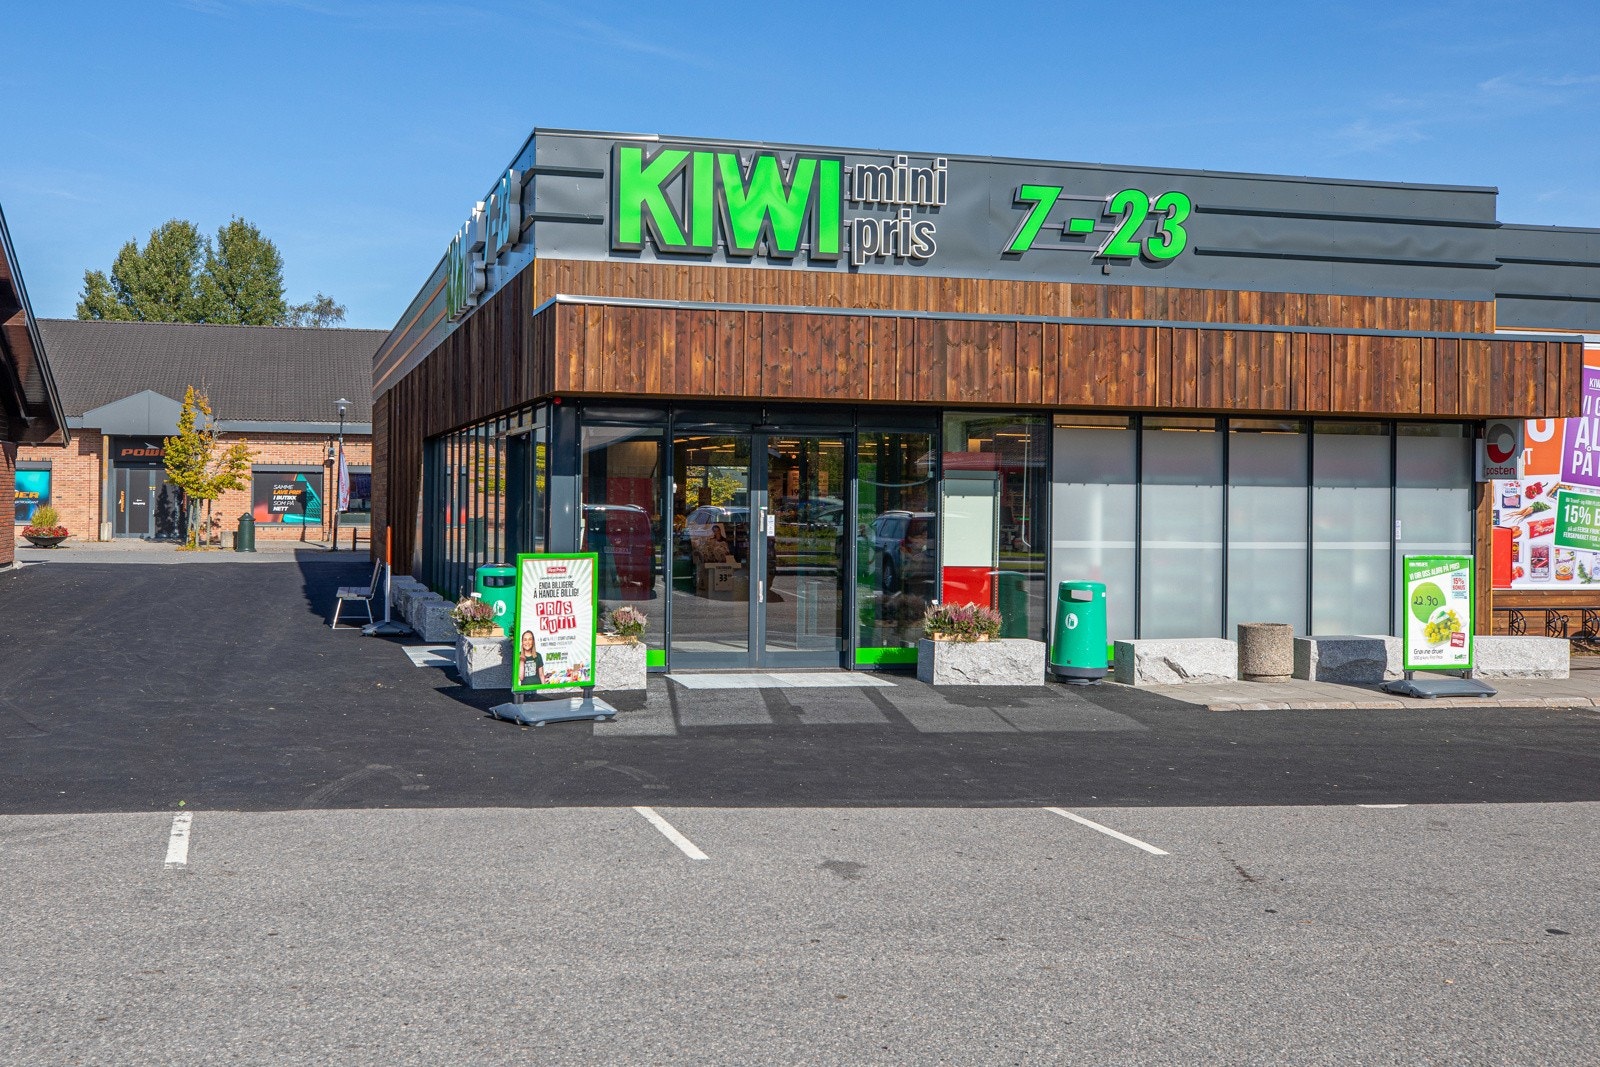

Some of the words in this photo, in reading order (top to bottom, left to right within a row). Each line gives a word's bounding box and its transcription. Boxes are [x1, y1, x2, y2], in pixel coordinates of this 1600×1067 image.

[855, 154, 948, 206] mini
[614, 144, 843, 257] KIWI
[853, 208, 937, 266] pris
[1486, 466, 1516, 476] posten
[1571, 445, 1593, 477] PÅ
[1564, 504, 1591, 525] 15%
[533, 588, 537, 598] Å
[539, 590, 559, 598] HANDLE
[561, 589, 579, 597] BILLIG!
[552, 580, 575, 589] BILLIGERE
[536, 601, 572, 615] PRIS
[540, 615, 576, 634] KUTT
